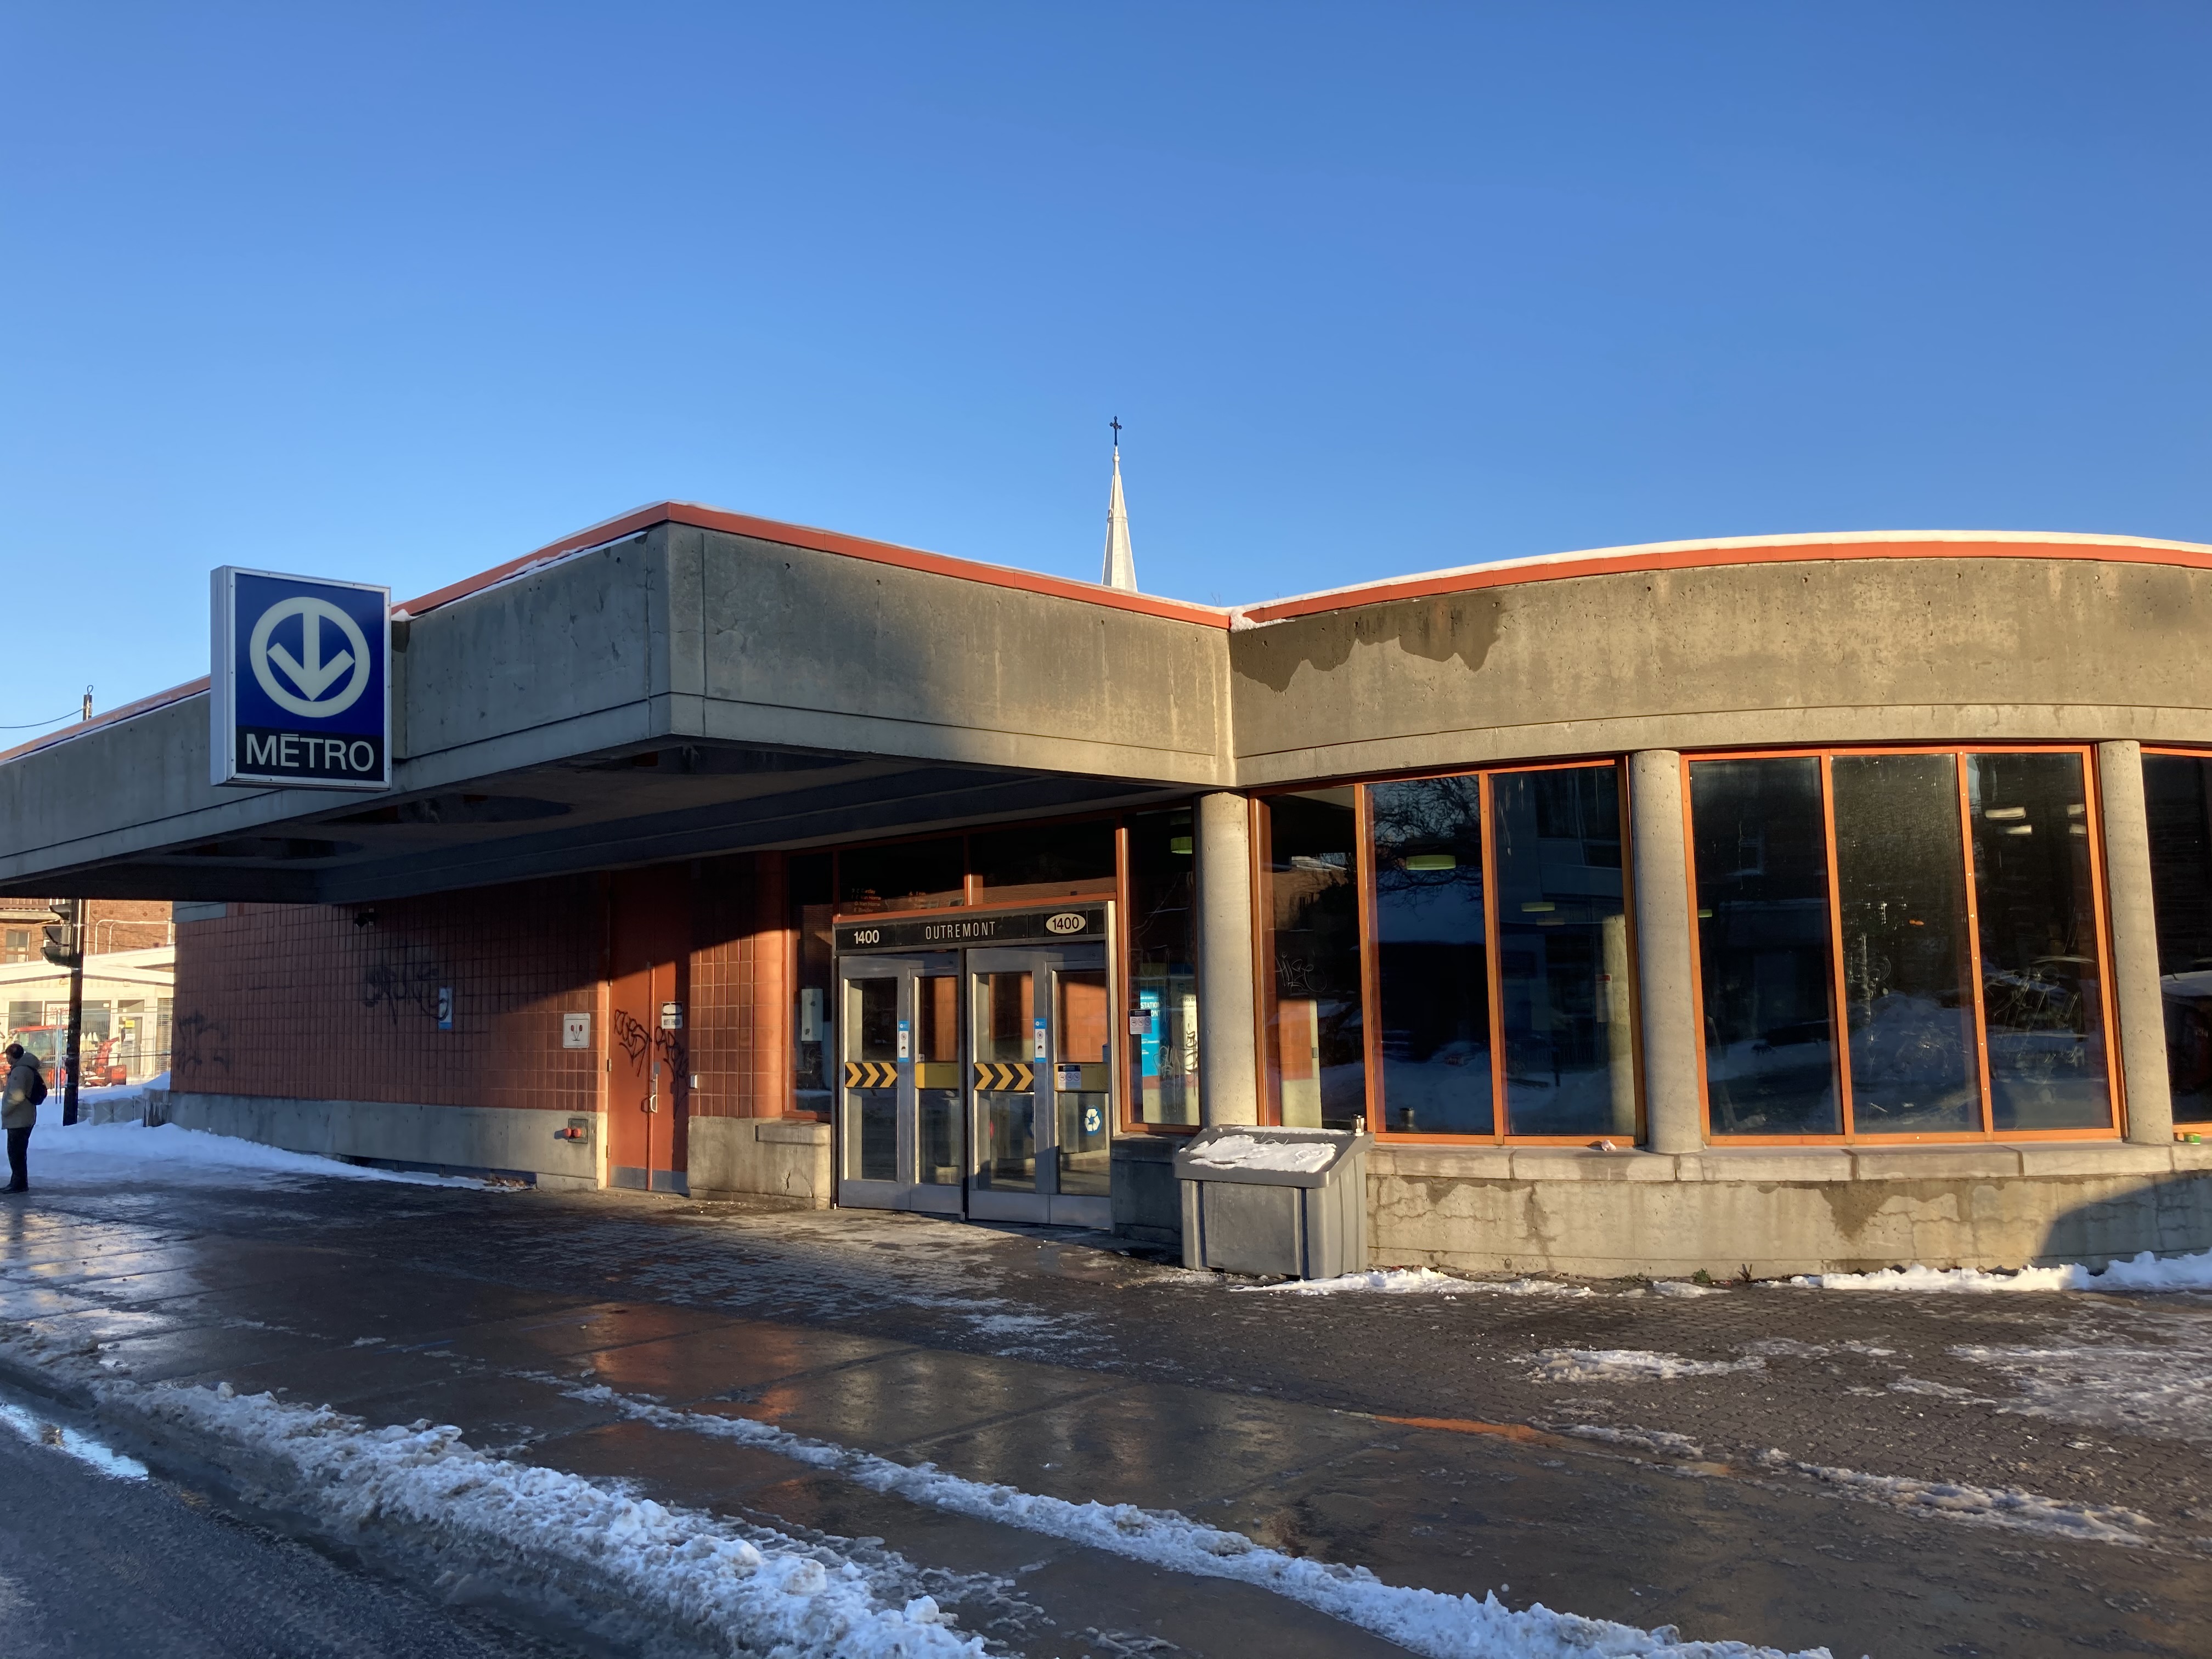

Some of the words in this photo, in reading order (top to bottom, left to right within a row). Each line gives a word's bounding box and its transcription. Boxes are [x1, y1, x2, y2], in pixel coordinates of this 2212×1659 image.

[854, 929, 879, 944] 1400
[926, 921, 996, 940] OUTREMONT
[1052, 916, 1080, 930] 1400
